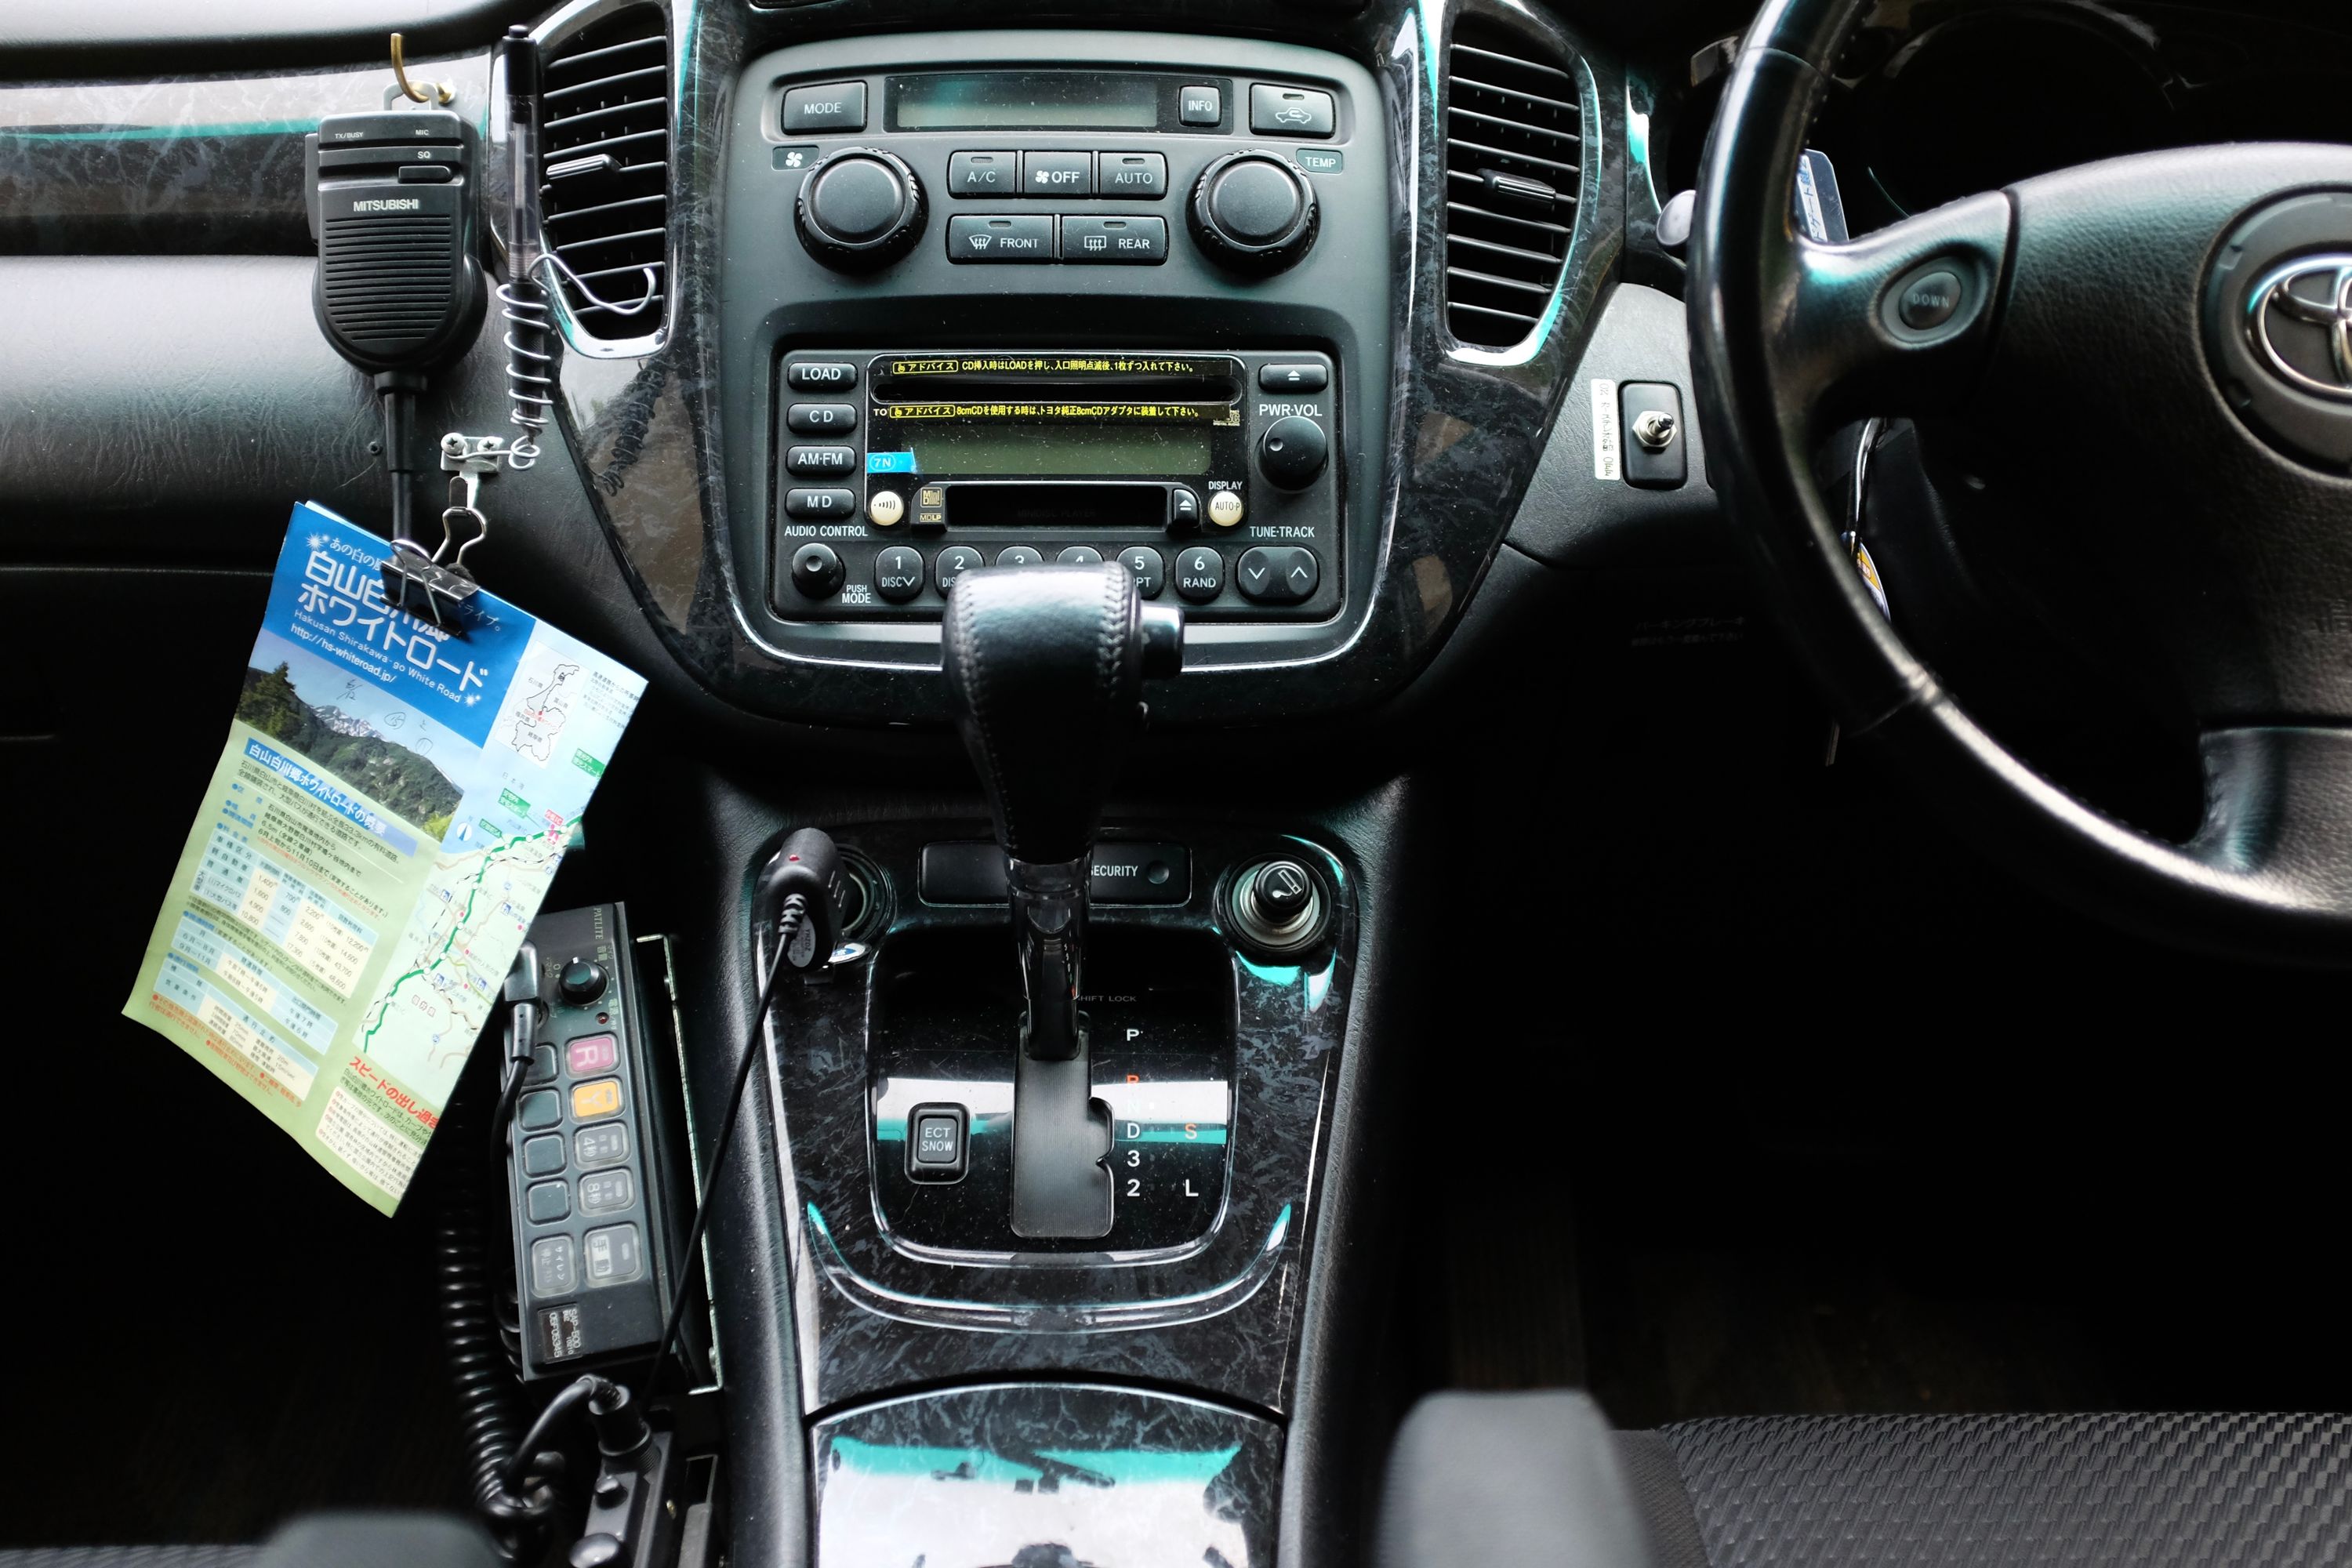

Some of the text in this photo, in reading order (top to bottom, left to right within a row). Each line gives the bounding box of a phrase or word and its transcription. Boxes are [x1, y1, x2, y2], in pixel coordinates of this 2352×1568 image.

[804, 102, 842, 114] MODE
[1188, 100, 1212, 112] INFO
[1305, 157, 1337, 169] TEMP
[967, 170, 996, 184] A/C
[1051, 170, 1080, 183] OFF
[1115, 172, 1153, 185] AUTO
[354, 199, 419, 212] MITSUBISHI
[1000, 238, 1039, 249] FRONT
[1118, 238, 1150, 249] REAR
[1913, 294, 1949, 307] DOWN
[802, 368, 840, 380] LOAD
[874, 458, 891, 468] 7N
[1208, 481, 1243, 490] DISPLAY
[785, 525, 868, 537] AUDIO CONTROL
[895, 556, 901, 569] 1
[954, 555, 964, 569] 2
[1134, 556, 1145, 570] 5
[1194, 556, 1205, 571] 6
[881, 576, 902, 587] DISC
[1134, 577, 1152, 587] PT
[1183, 578, 1216, 588] RAND
[846, 584, 867, 593] PUSH
[842, 593, 871, 604] MODE
[297, 581, 489, 690] ホワイトロード
[289, 621, 397, 686] http://hs-whiteroad.jp/
[292, 608, 337, 637] Hakusan
[405, 666, 437, 688] White
[435, 683, 463, 703] Road
[1091, 866, 1138, 877] ECURITY
[590, 909, 604, 940] PATLITE
[595, 945, 608, 962] 音量
[1127, 1029, 1140, 1040] P
[574, 1044, 599, 1067] R
[579, 1090, 603, 1110] Y
[925, 1127, 951, 1138] ECT
[1127, 1122, 1141, 1139] D
[1185, 1123, 1198, 1140] S
[581, 1135, 597, 1158] 4秒
[921, 1140, 953, 1152] SNOW
[1127, 1149, 1141, 1167] 3
[586, 1181, 602, 1205] 8秒
[1127, 1178, 1141, 1196] 2
[1185, 1178, 1199, 1197] L
[553, 1246, 566, 1281] サイレン
[567, 1308, 581, 1348] SAP-500
